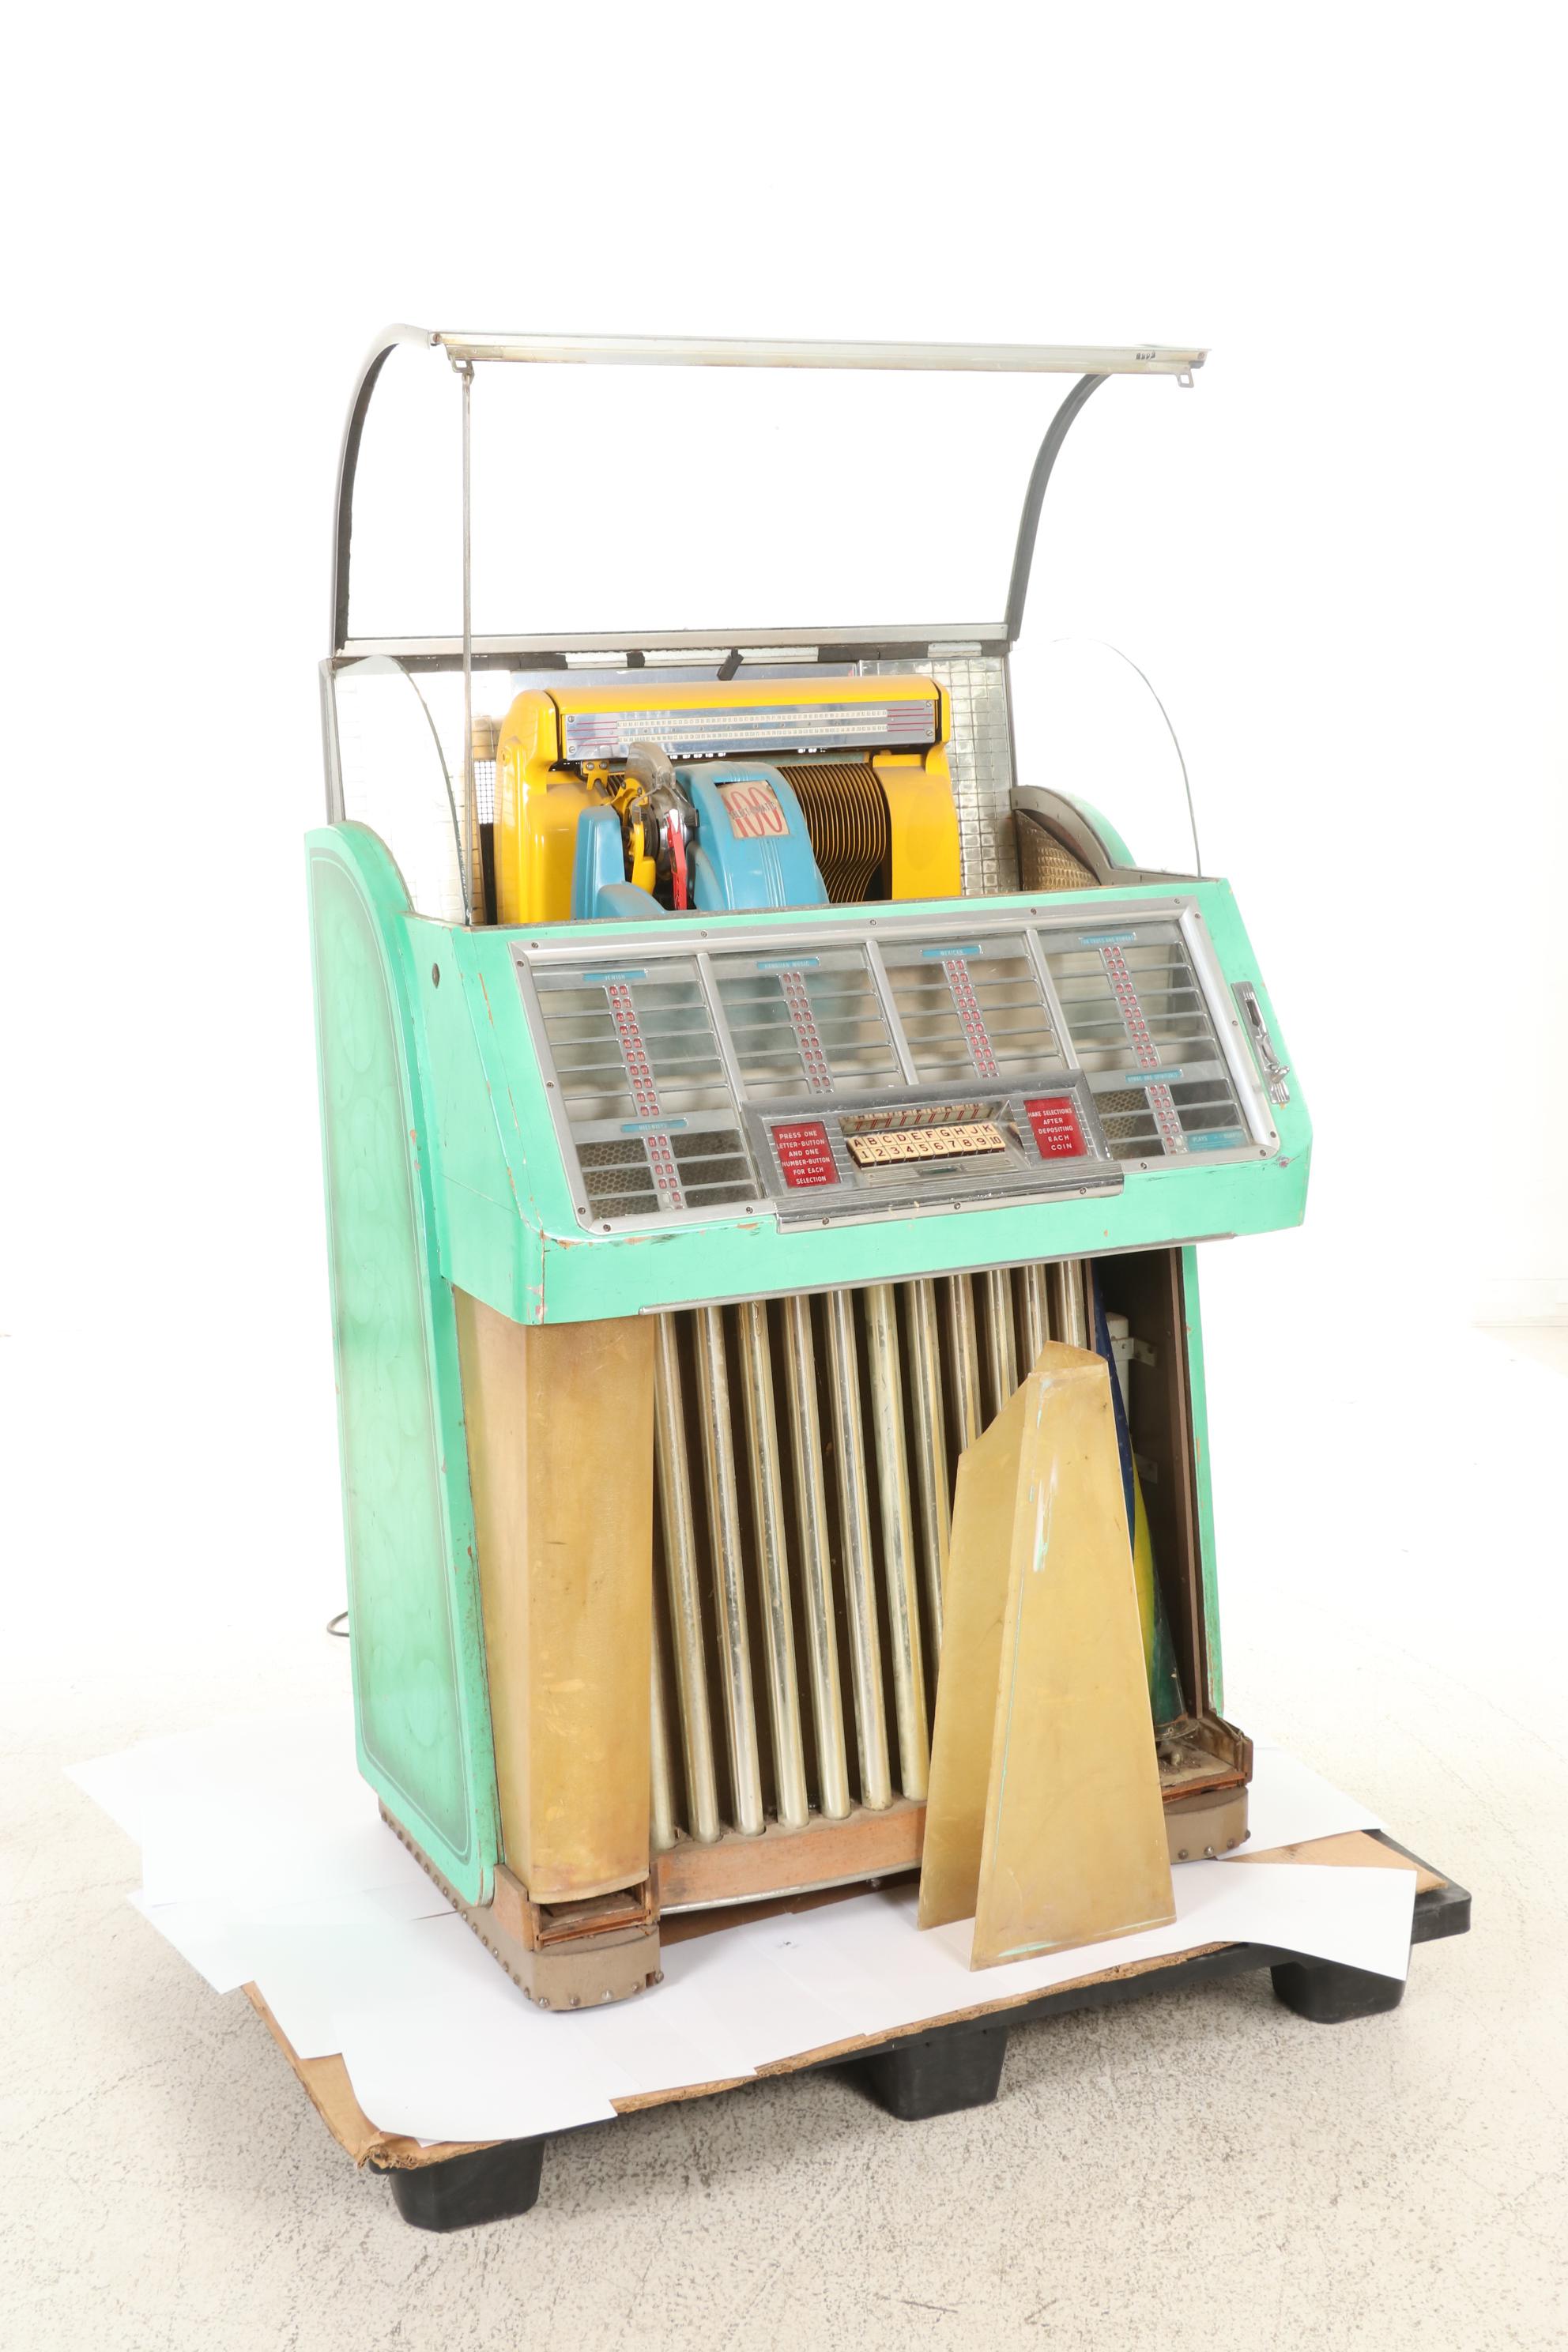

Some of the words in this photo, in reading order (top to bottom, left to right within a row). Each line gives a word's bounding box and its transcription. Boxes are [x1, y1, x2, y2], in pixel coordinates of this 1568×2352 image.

[1038, 1125, 1073, 1134] DEPOSITING
[777, 1139, 825, 1149] LETTER-BUTTON
[782, 1157, 831, 1167] NUMBER-BUTTON
[796, 1176, 827, 1185] SELECTION
